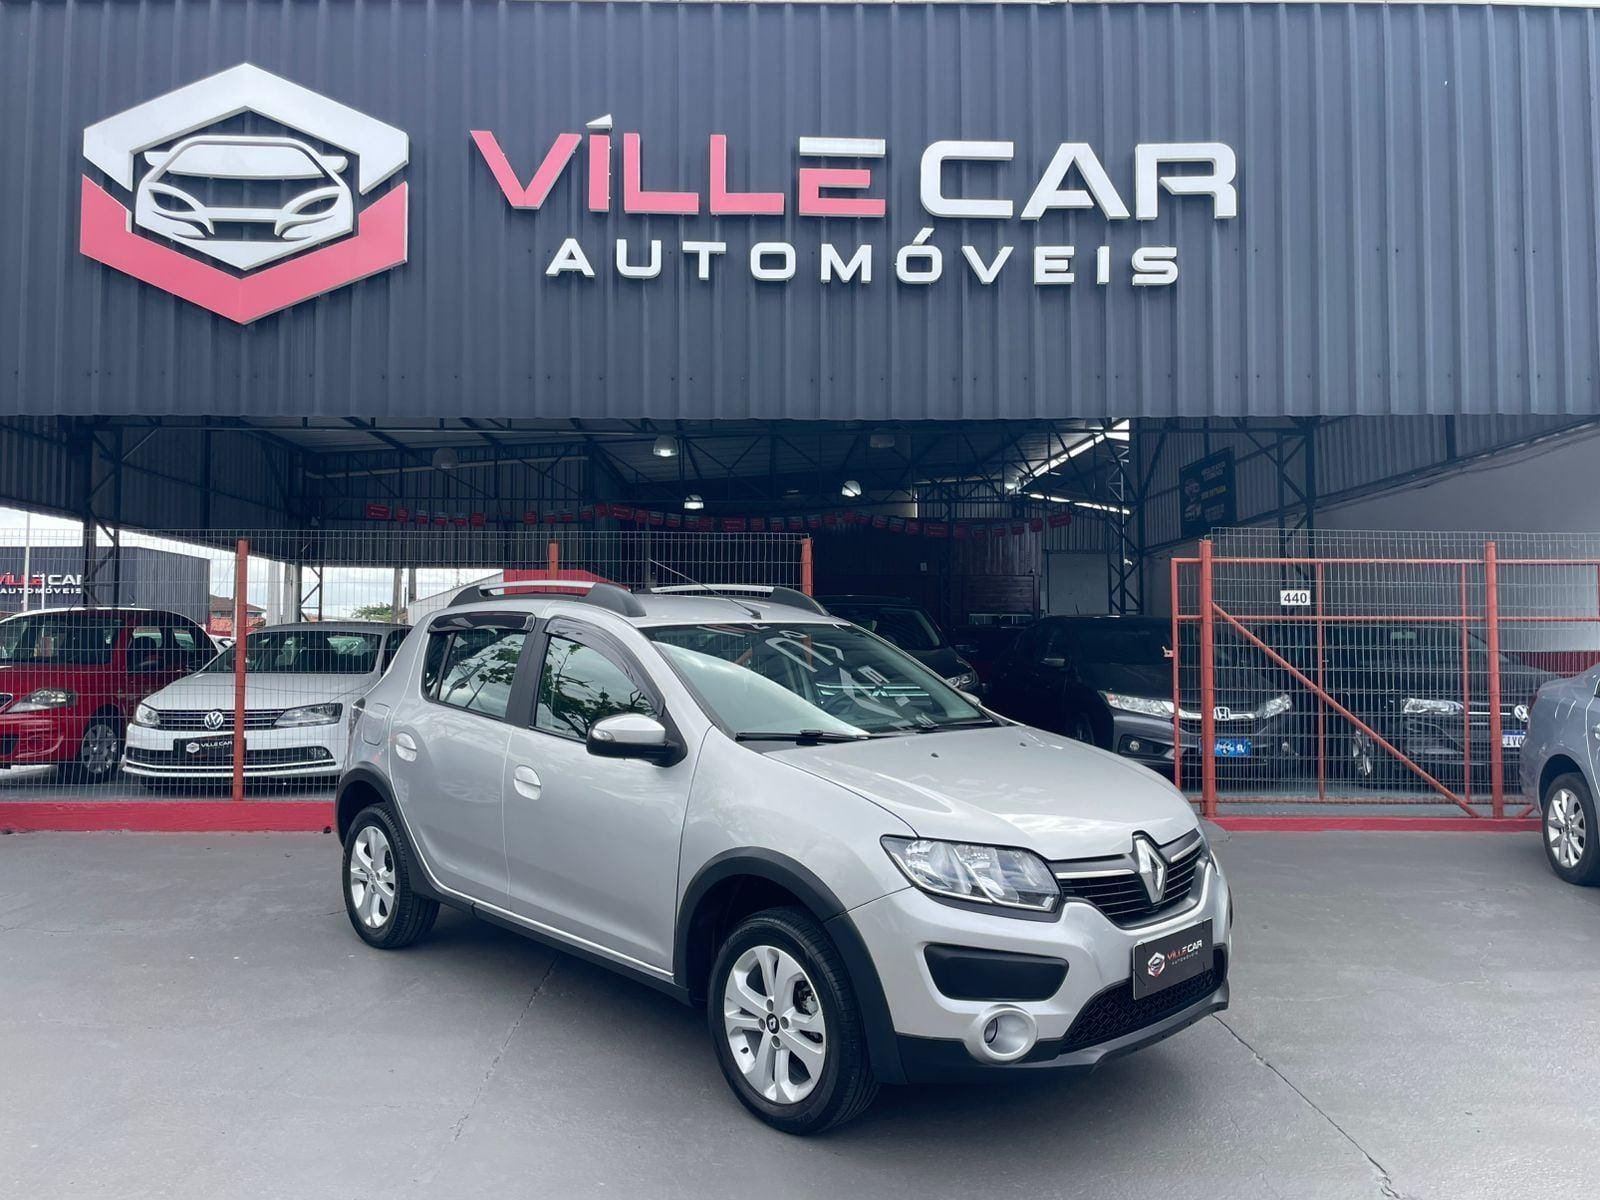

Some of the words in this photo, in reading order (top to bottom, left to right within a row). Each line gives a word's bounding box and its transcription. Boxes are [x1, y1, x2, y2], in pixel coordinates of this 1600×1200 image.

[920, 139, 1238, 221] CAR
[545, 226, 1179, 287] AUTOMÓVEIS
[1283, 592, 1308, 604] 440
